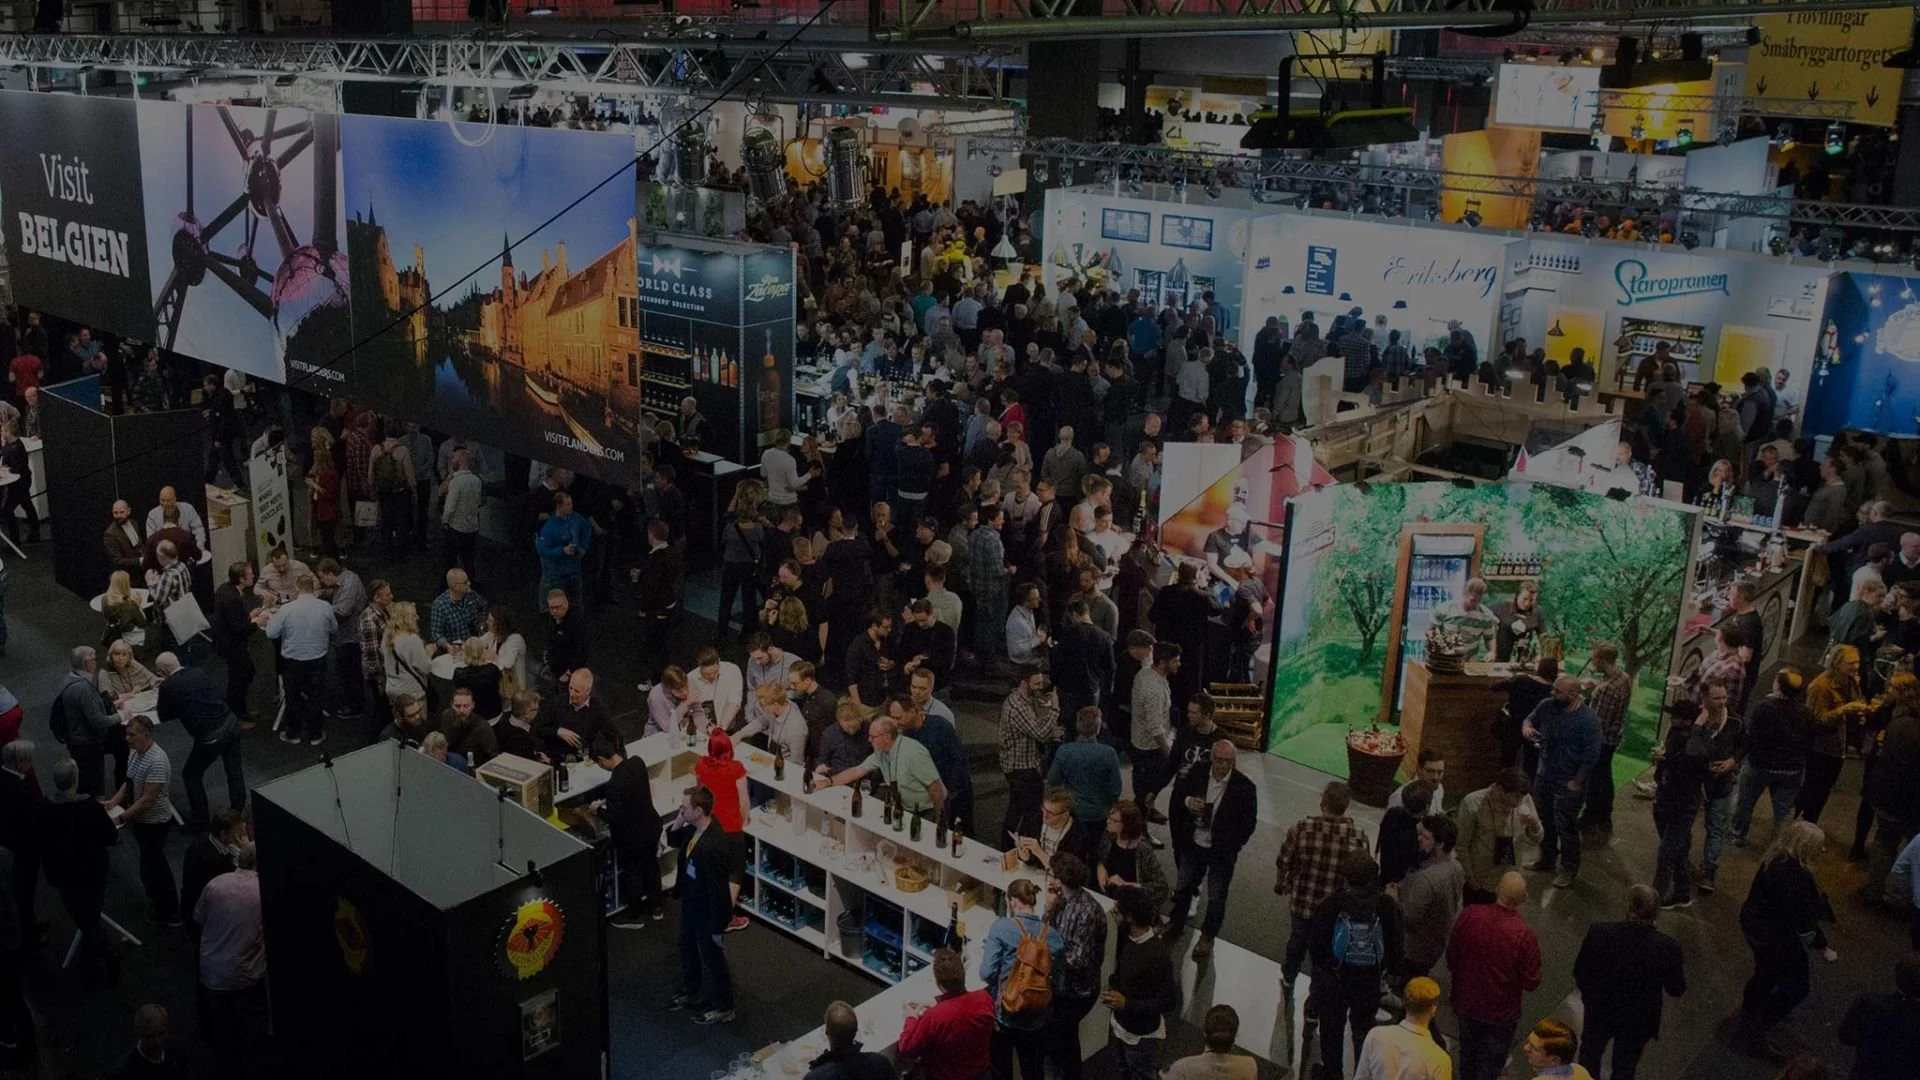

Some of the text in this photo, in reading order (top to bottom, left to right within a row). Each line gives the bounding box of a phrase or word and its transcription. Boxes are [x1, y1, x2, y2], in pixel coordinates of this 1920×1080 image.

[39, 152, 94, 205] Visit
[18, 211, 130, 279] BELGIEN
[637, 277, 712, 300] ORLD CLASS
[1614, 259, 1730, 306] Staropramen
